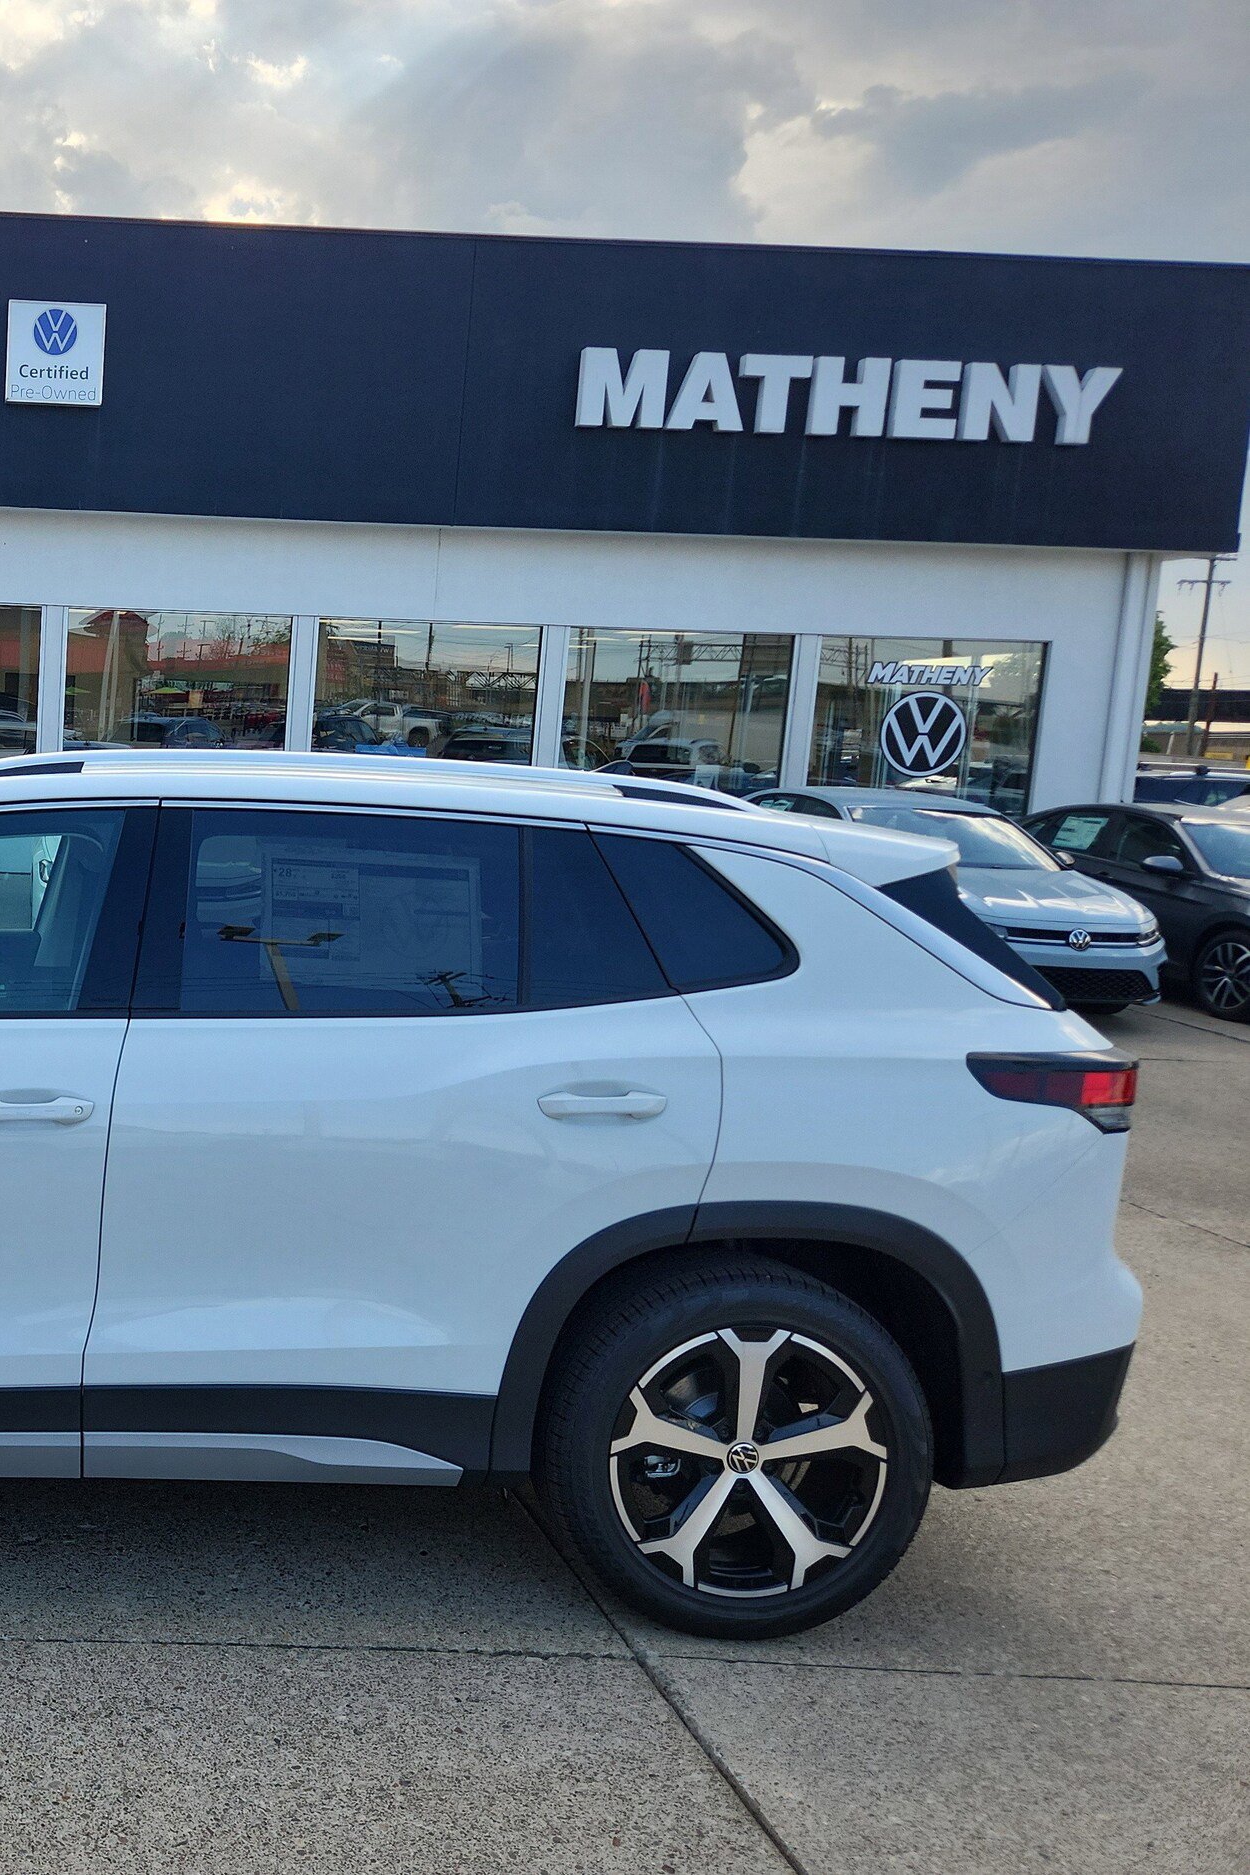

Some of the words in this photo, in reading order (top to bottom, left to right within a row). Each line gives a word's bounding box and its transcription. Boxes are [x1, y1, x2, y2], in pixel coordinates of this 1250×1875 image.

[34, 309, 77, 355] VW
[19, 364, 89, 381] Certified
[10, 384, 97, 401] Pre-Owned
[574, 346, 1123, 446] MATHENY
[866, 661, 994, 686] MATHENY
[880, 691, 967, 777] VW
